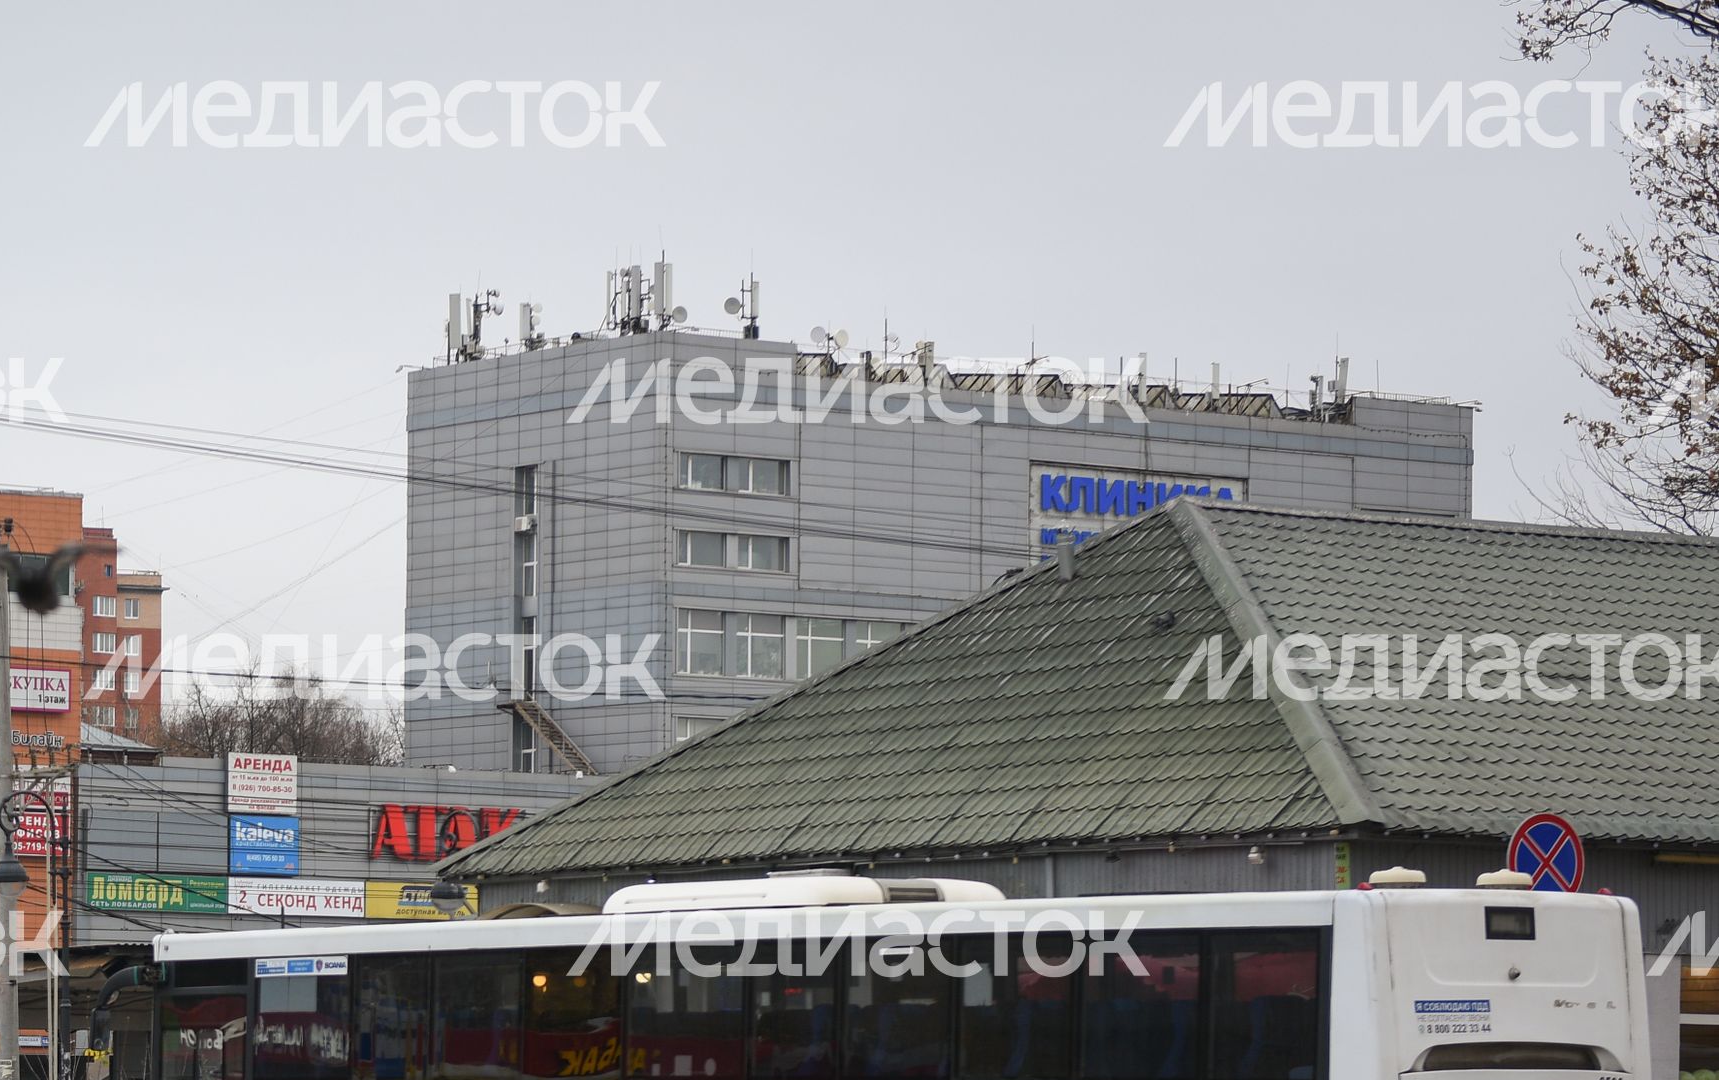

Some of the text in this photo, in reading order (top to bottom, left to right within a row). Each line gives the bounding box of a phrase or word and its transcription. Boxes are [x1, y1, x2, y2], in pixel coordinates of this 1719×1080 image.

[10, 676, 66, 691] КУПКА
[44, 695, 67, 704] этаж
[233, 757, 292, 773] АРЕНДА
[235, 821, 294, 843] kaleva
[92, 877, 183, 908] Ломбард
[239, 889, 247, 903] 2
[111, 901, 157, 909] ЛОМБАРДОВ
[257, 893, 363, 912] СЕКОНД ХЕНД
[1434, 1024, 1450, 1033] 800
[1451, 1024, 1467, 1033] 222
[1481, 1023, 1491, 1033] 44
